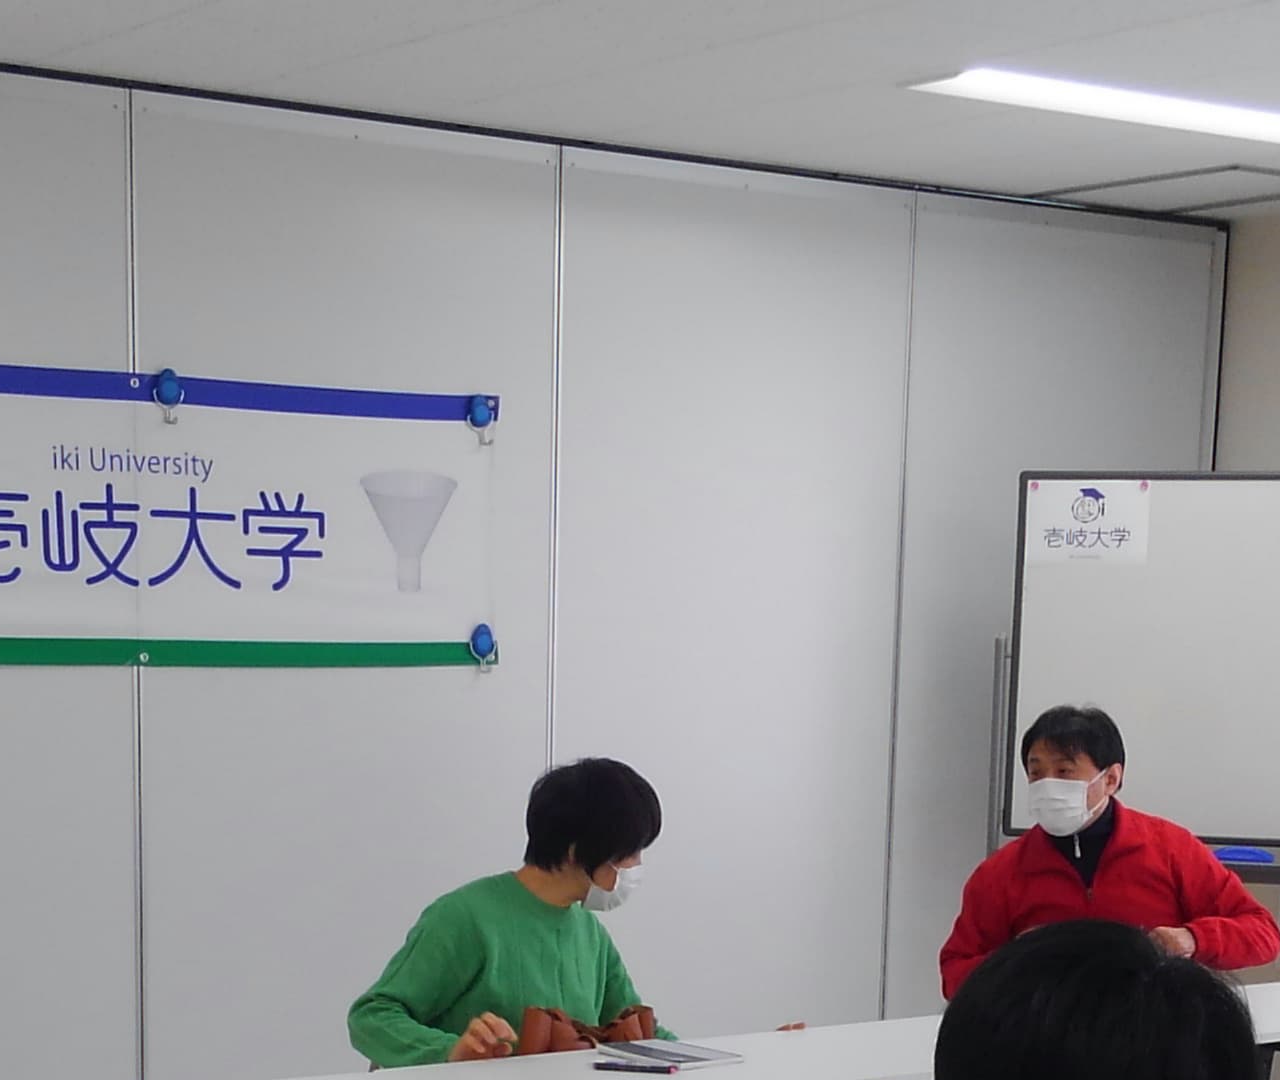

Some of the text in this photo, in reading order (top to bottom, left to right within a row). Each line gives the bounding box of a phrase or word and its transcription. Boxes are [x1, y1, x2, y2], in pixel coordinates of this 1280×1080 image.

[51, 445, 215, 483] iki University
[1043, 527, 1131, 549] 壱岐大学
